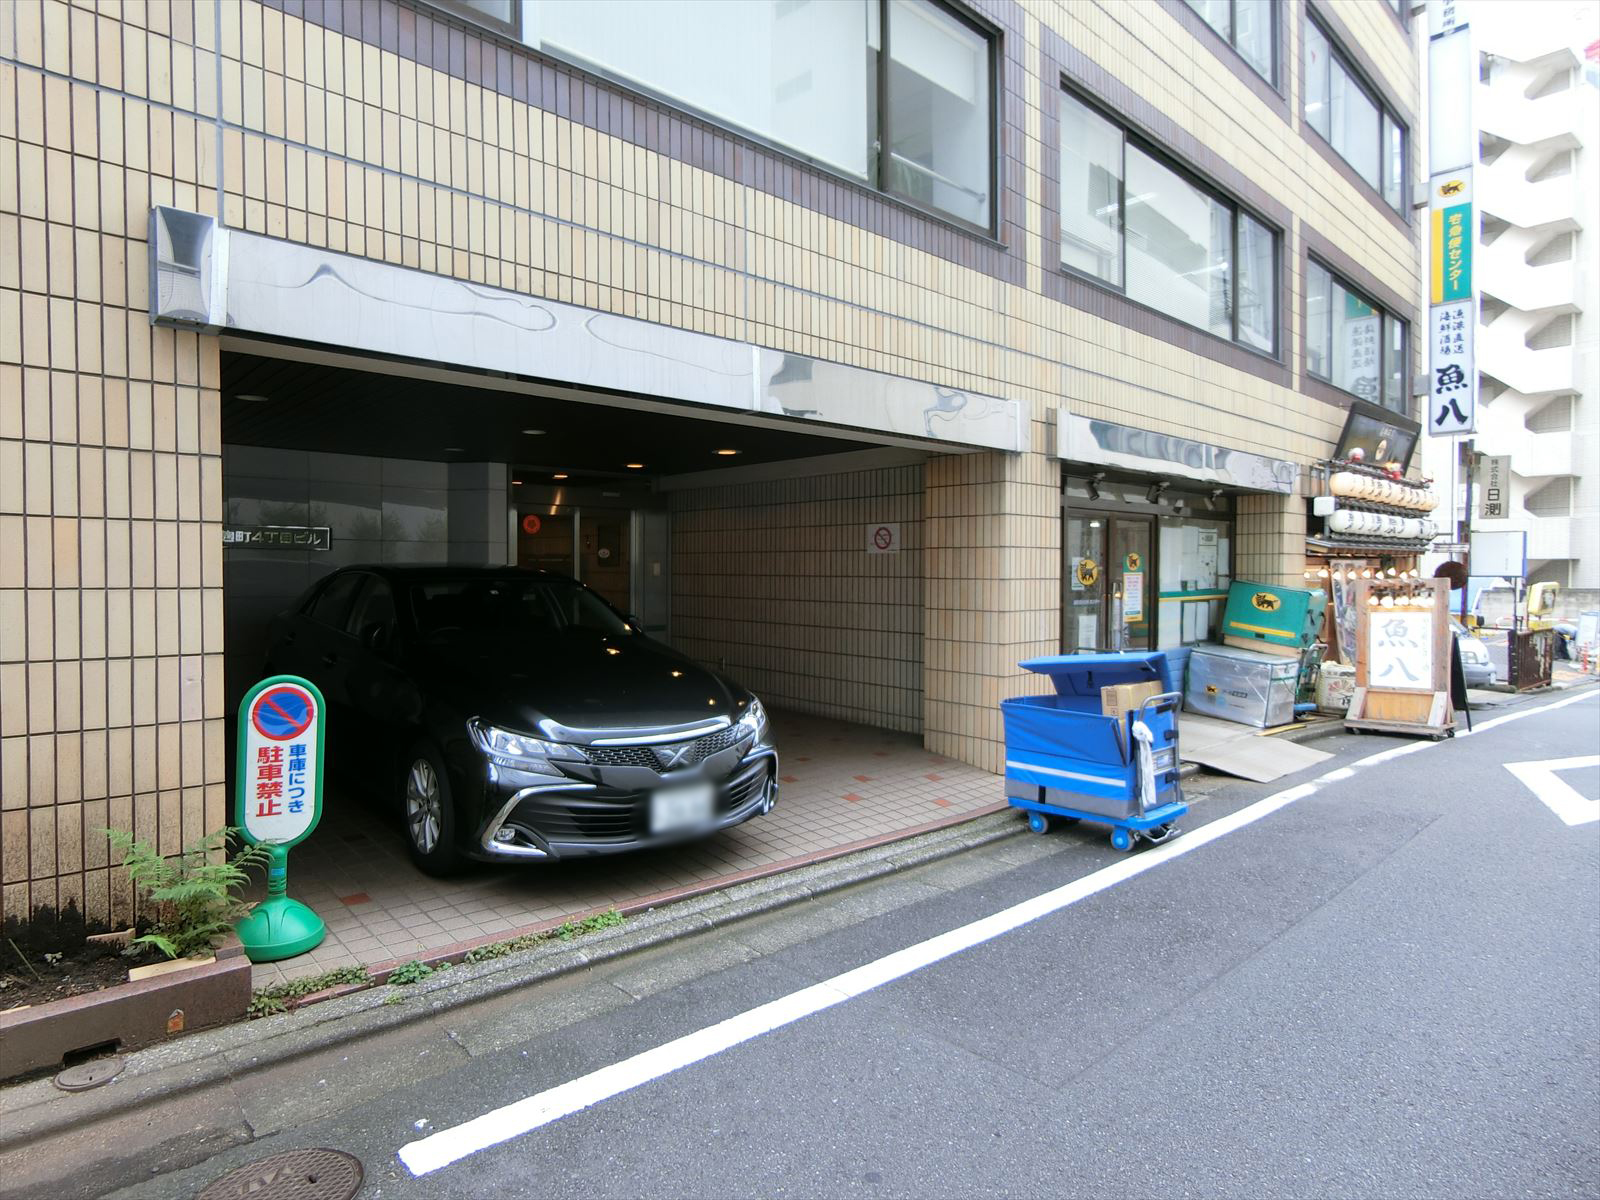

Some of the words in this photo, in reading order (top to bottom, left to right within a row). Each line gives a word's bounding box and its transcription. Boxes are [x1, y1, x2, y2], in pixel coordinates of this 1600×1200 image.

[1449, 214, 1462, 290] 宅急便センター
[1439, 310, 1452, 356] 海鮮酒場
[1434, 363, 1469, 427] 魚八
[1377, 618, 1421, 682] 魚八
[256, 746, 284, 818] 駐車禁止
[288, 743, 307, 813] 車庫につき
